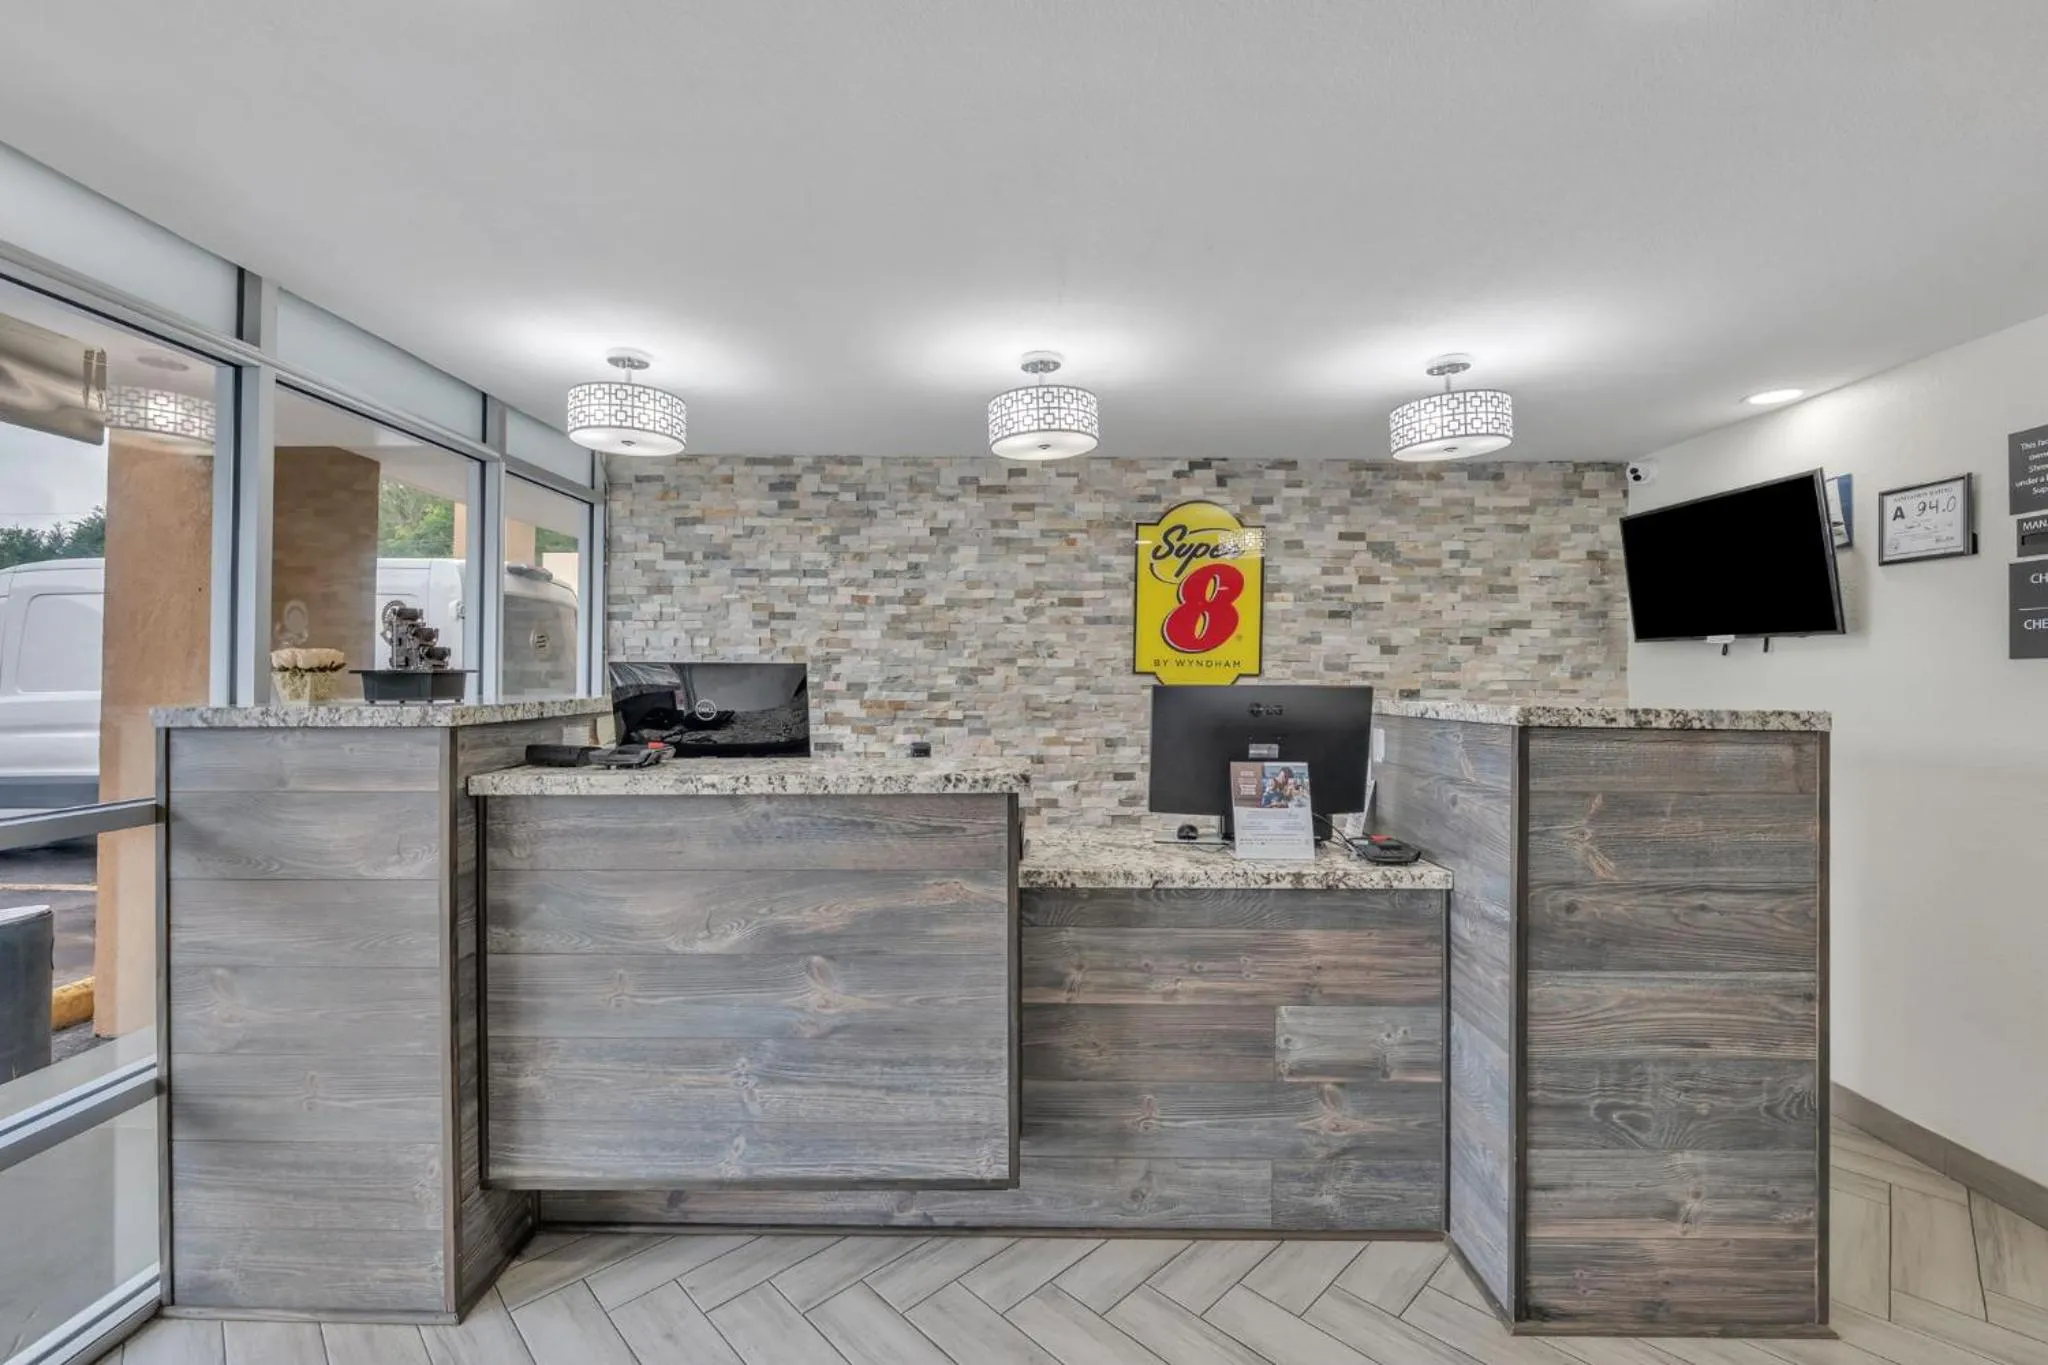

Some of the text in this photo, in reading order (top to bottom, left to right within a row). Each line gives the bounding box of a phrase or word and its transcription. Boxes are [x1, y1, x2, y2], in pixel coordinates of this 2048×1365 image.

[1892, 496, 1957, 521] A 94.0
[2022, 519, 2048, 531] MAN
[1160, 562, 1245, 655] 8
[2023, 618, 2048, 630] CHE
[1153, 659, 1242, 669] BY WYNDHAM
